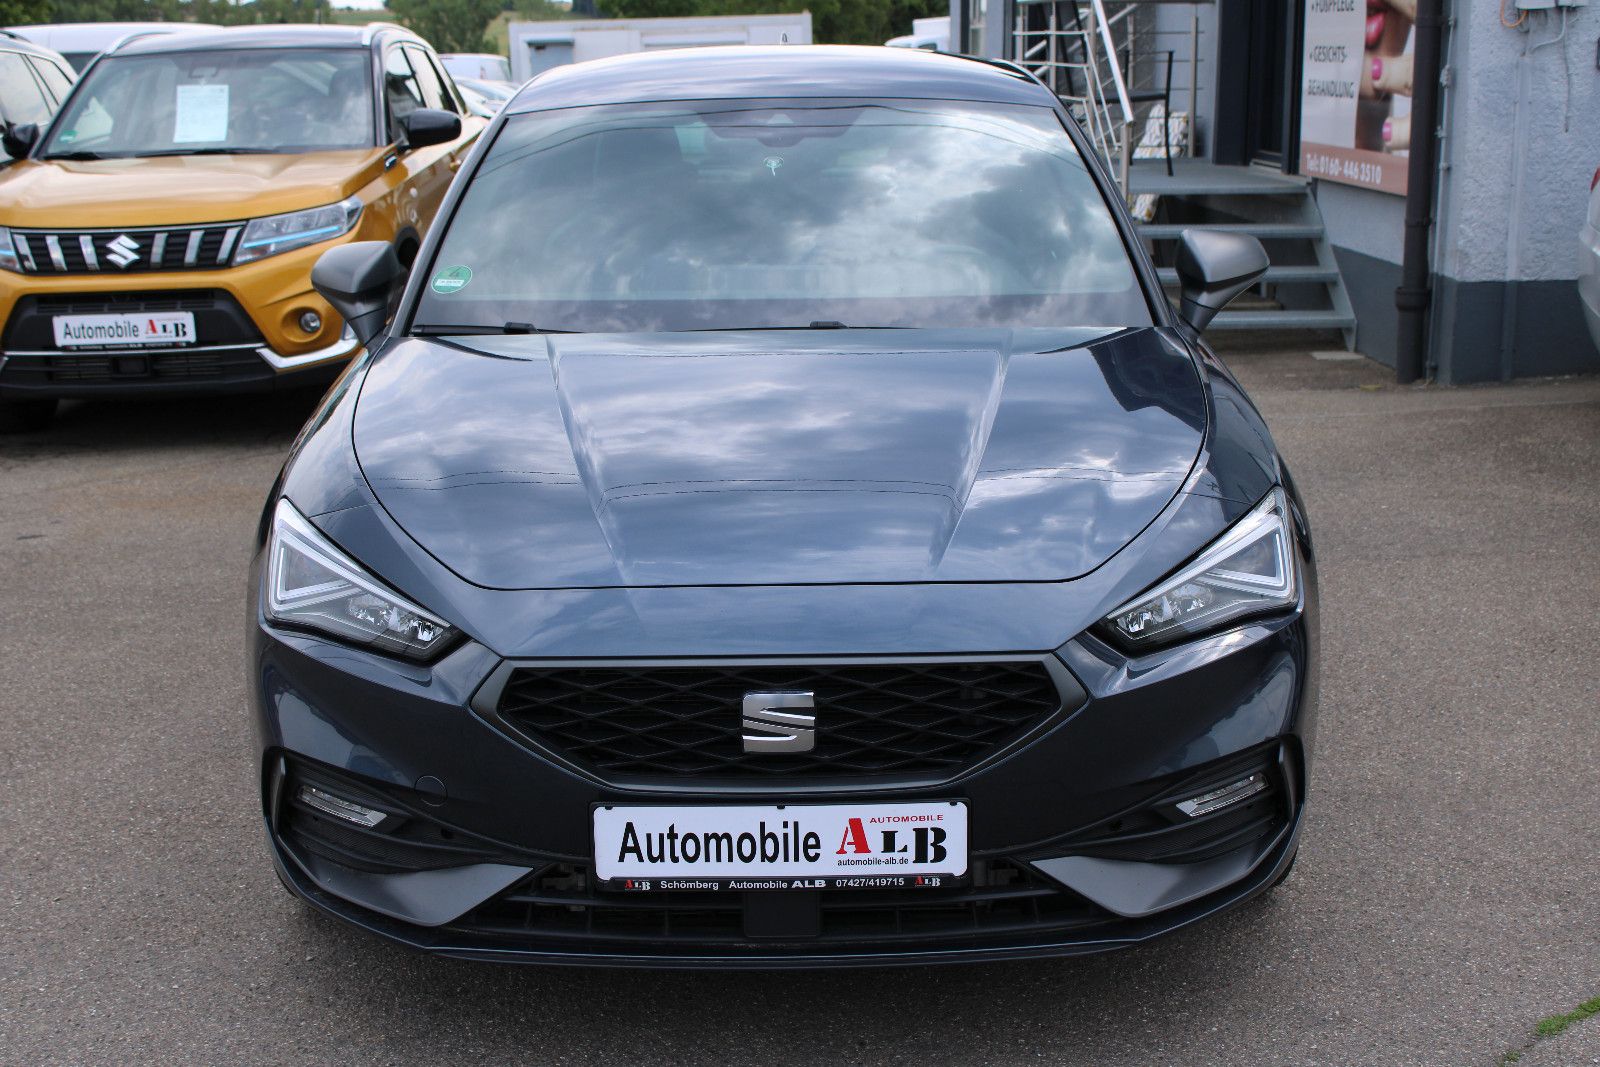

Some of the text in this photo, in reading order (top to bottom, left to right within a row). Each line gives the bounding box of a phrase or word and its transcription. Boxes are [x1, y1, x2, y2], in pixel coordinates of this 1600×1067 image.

[1308, 79, 1354, 98] BEHANDLUNG
[63, 319, 187, 339] Automobile ALB
[869, 814, 944, 824] AUTOMOBILE
[617, 817, 948, 865] Automobile ALB
[837, 857, 909, 866] automobile-alb.de
[625, 876, 941, 892] ALB Schömberg Automobile ALB 07427/419715 ALB
